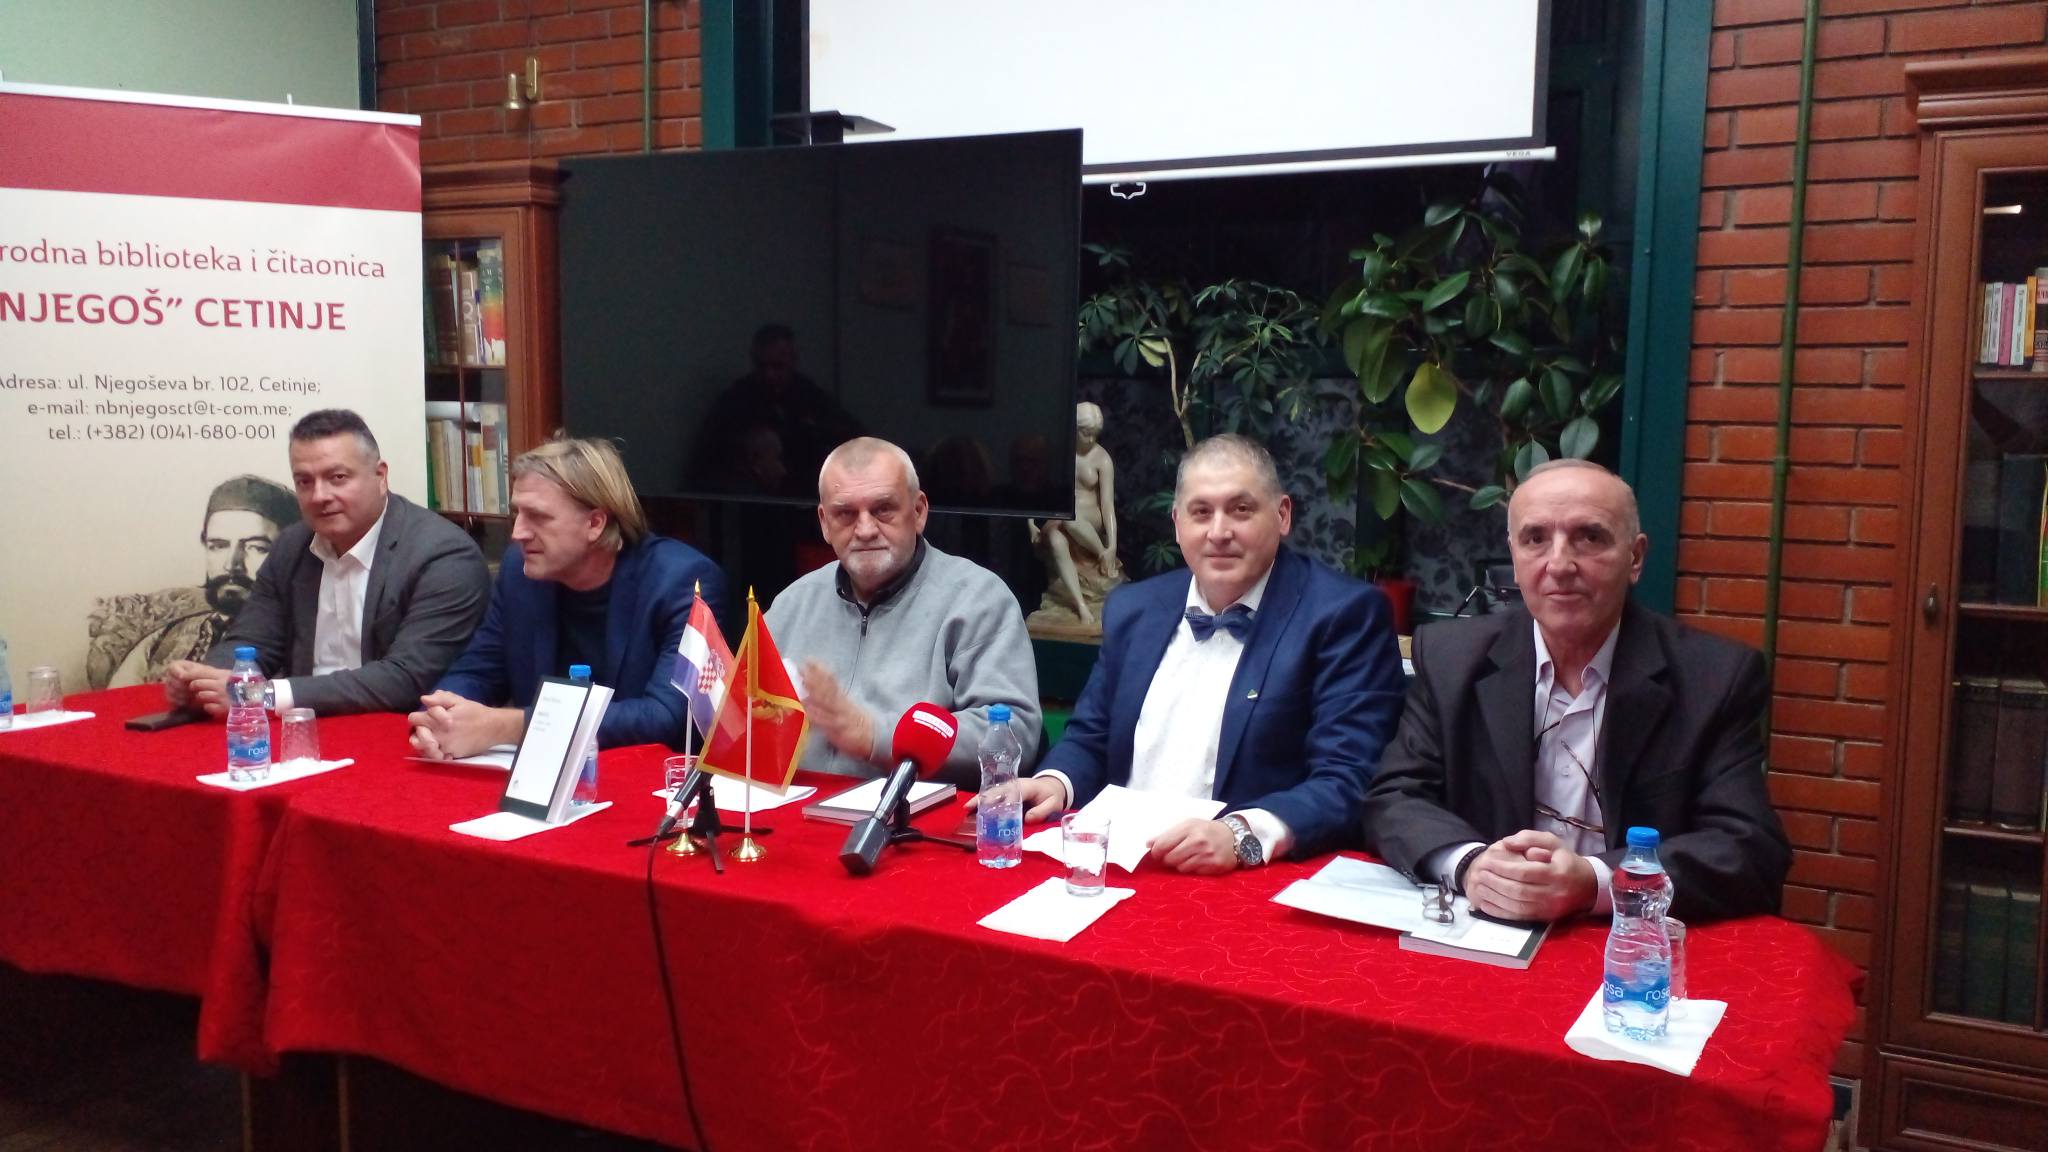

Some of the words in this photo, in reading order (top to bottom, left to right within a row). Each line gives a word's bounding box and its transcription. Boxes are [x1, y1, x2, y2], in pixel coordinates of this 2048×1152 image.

[97, 241, 241, 271] biblioteka
[251, 249, 257, 272] i
[266, 249, 385, 278] čitaonica
[195, 298, 347, 330] CETINJE
[67, 374, 89, 390] ul.
[95, 375, 187, 394] Njegoševa
[193, 376, 215, 391] br.
[220, 376, 254, 393] 102,
[259, 376, 321, 396] Cetinje;
[28, 400, 89, 415] e-mail:
[95, 400, 292, 419] nbnjegosct@t-com.me;
[48, 424, 81, 440] tel.:
[87, 424, 145, 440] (+382)
[150, 424, 276, 440] (0)41-680-001
